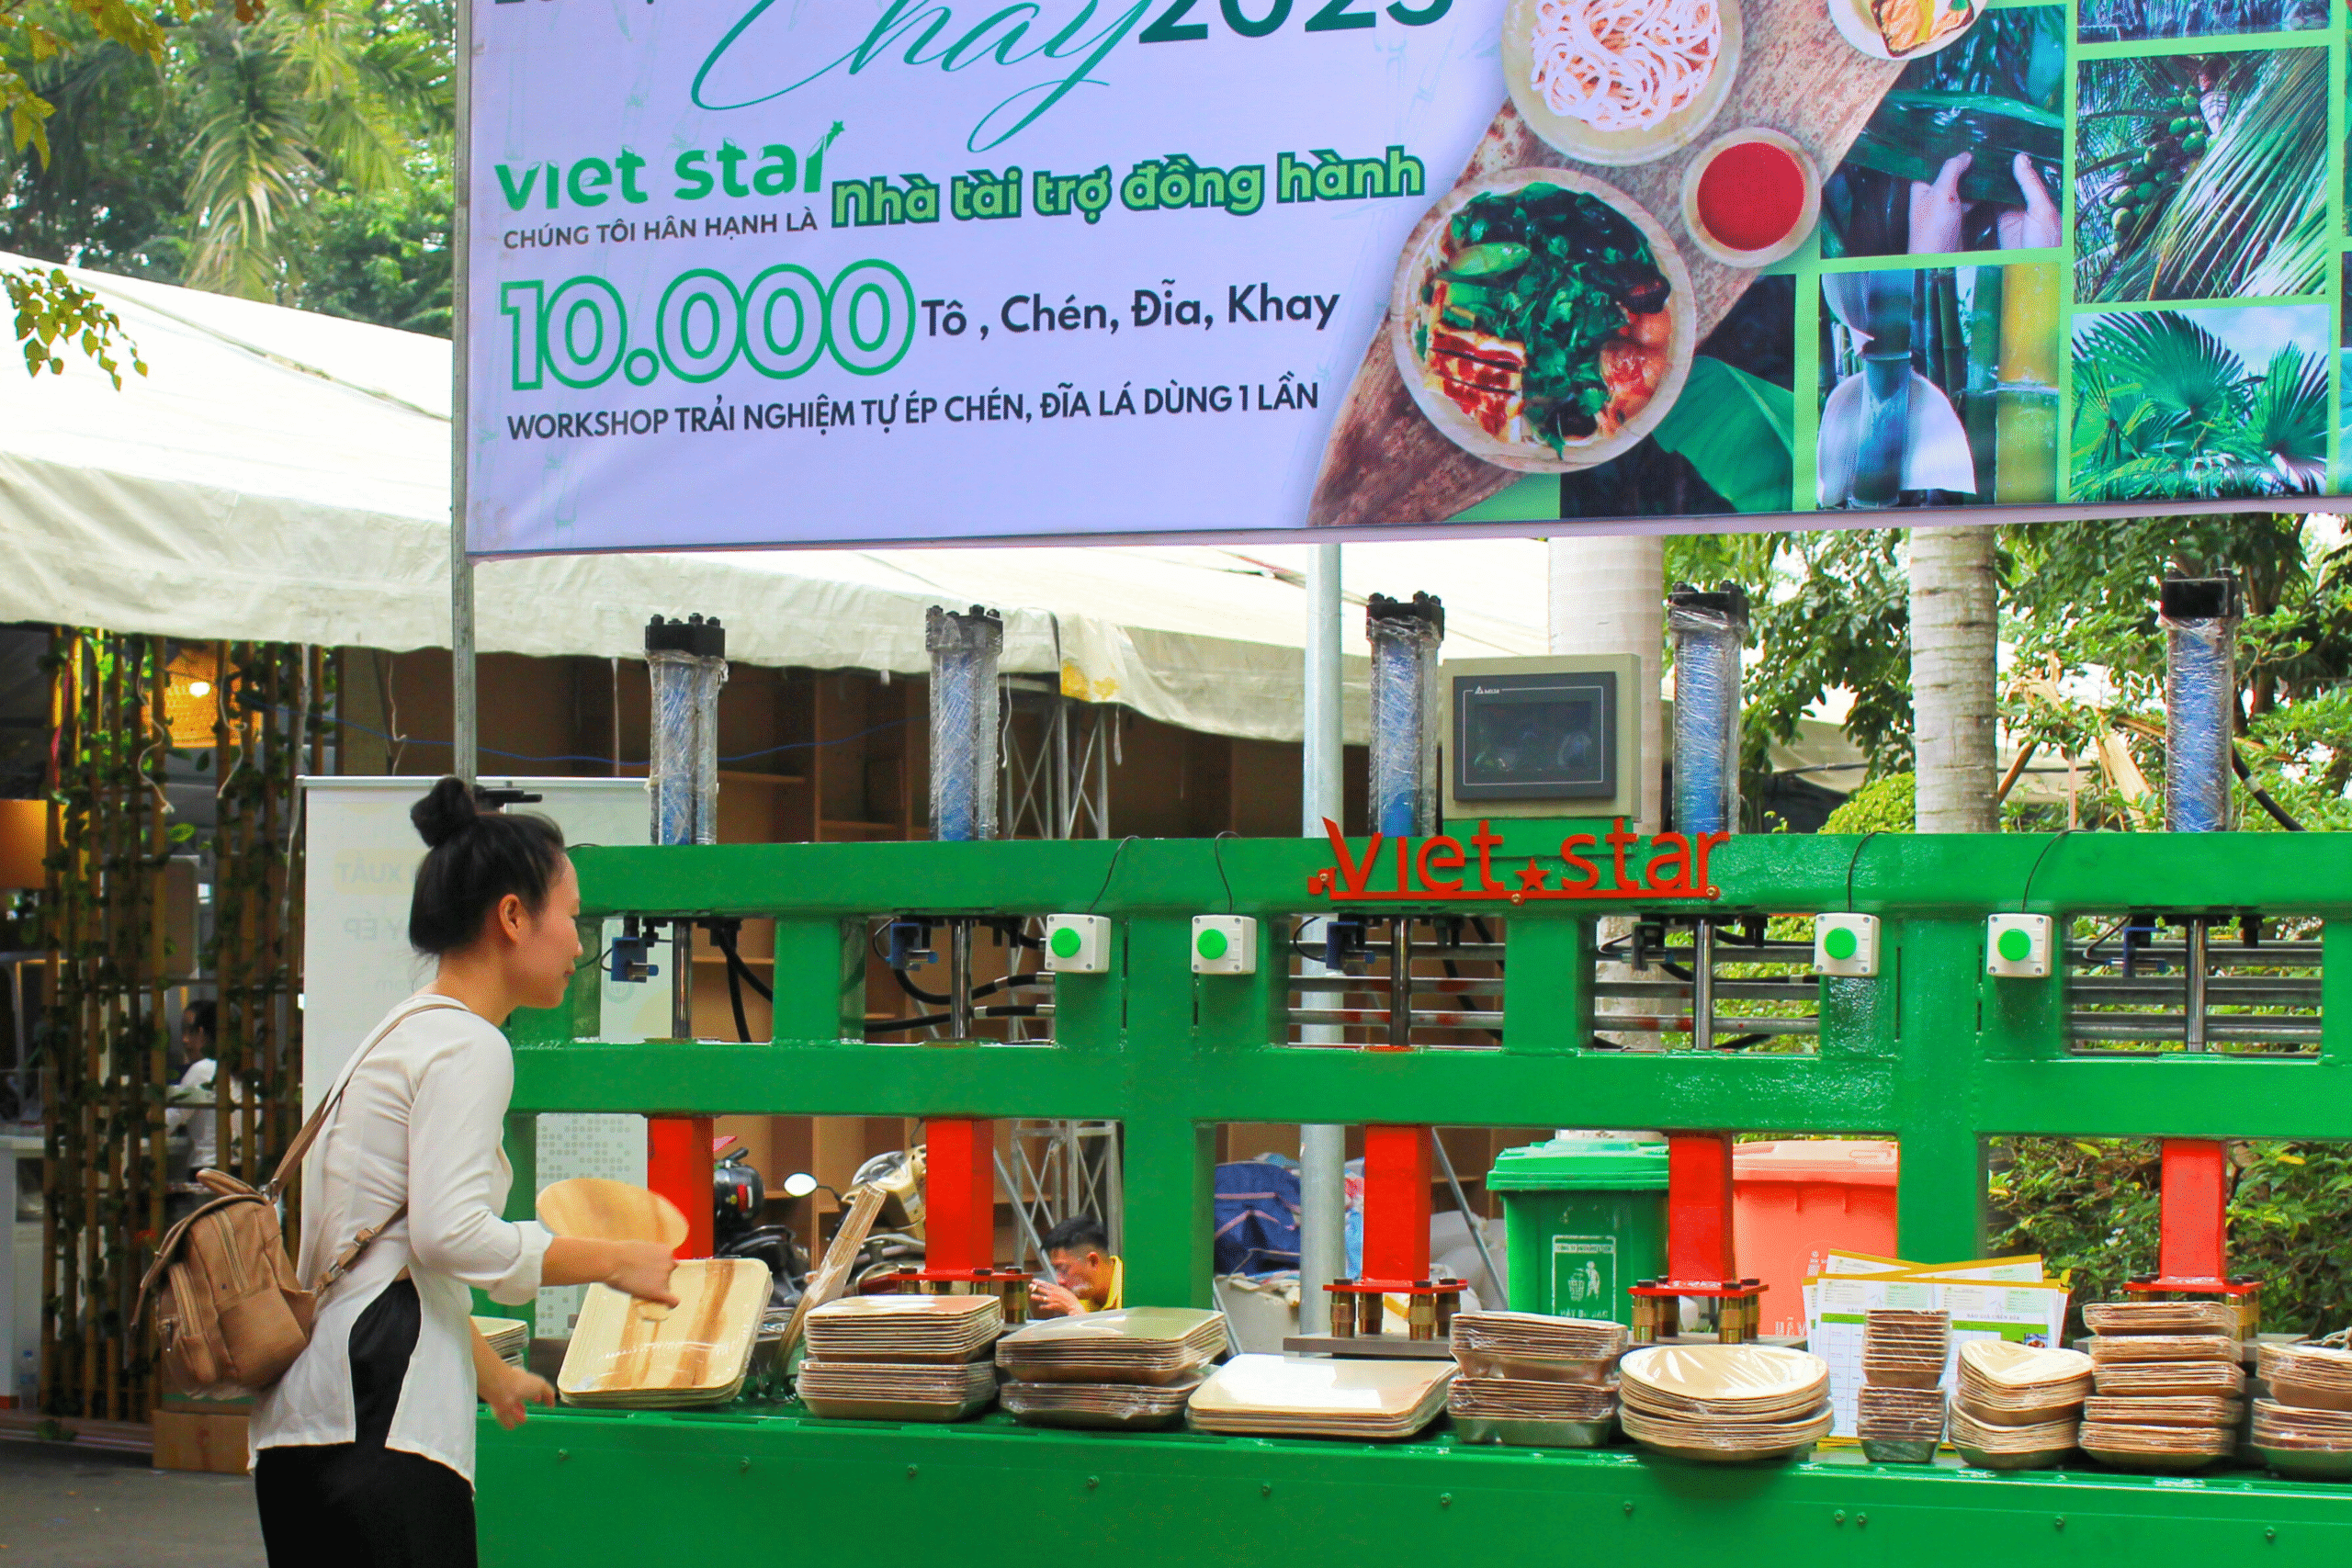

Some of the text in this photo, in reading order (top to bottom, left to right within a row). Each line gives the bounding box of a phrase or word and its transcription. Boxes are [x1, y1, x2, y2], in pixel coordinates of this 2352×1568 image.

[831, 145, 1425, 228] nhà tài trợ đồng hành
[503, 206, 819, 250] CHÚNG TÔI HÂN HẠNH LÀ
[501, 258, 917, 391] 10.000
[921, 299, 968, 337] Tô
[1001, 292, 1120, 335] Chén,
[1131, 279, 1215, 331] Đĩa,
[1227, 282, 1341, 332] Khay
[507, 371, 1319, 441] WORKSHOP TRẢI NGHIỆM TỰ ÉP CHÉN, ĐĨA LÁ DÙNG 1 LẦN
